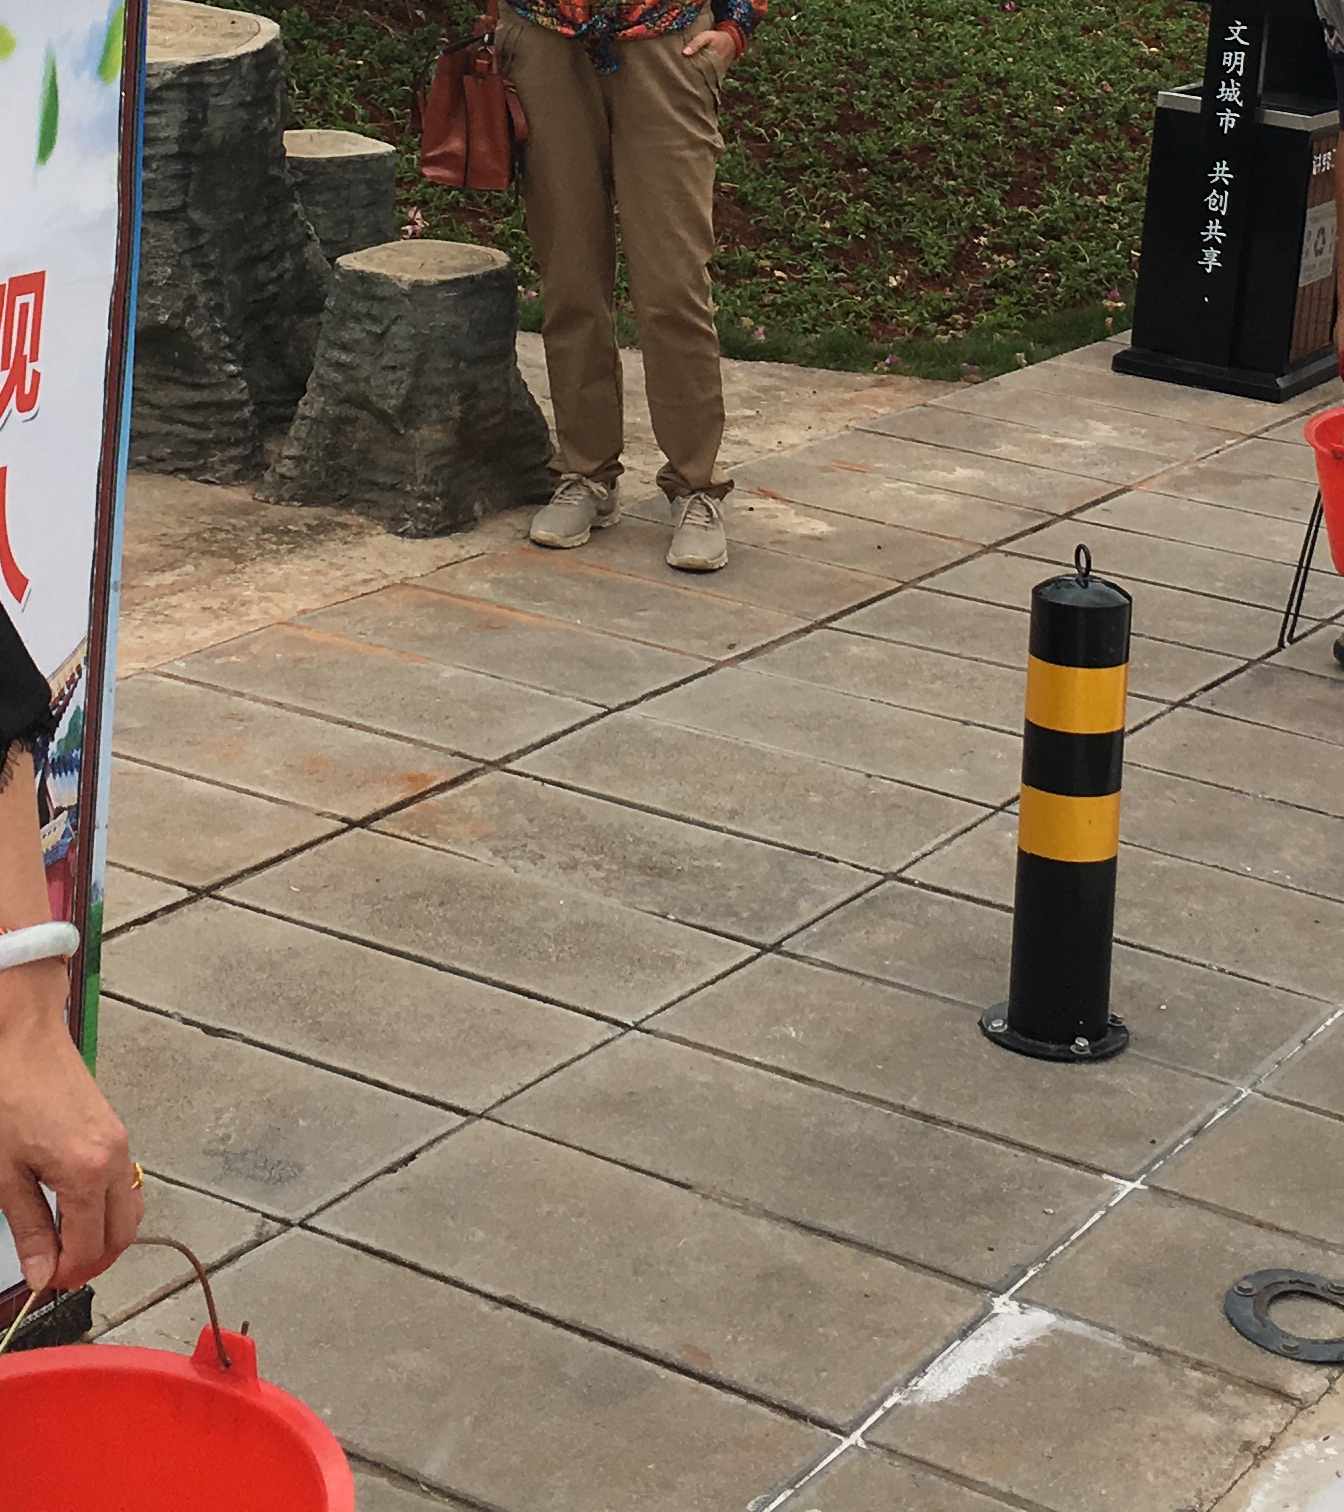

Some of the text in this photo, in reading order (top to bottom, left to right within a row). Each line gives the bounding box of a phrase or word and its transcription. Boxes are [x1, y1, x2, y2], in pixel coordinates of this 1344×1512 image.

[1197, 19, 1251, 274] 文明城市 共创共享
